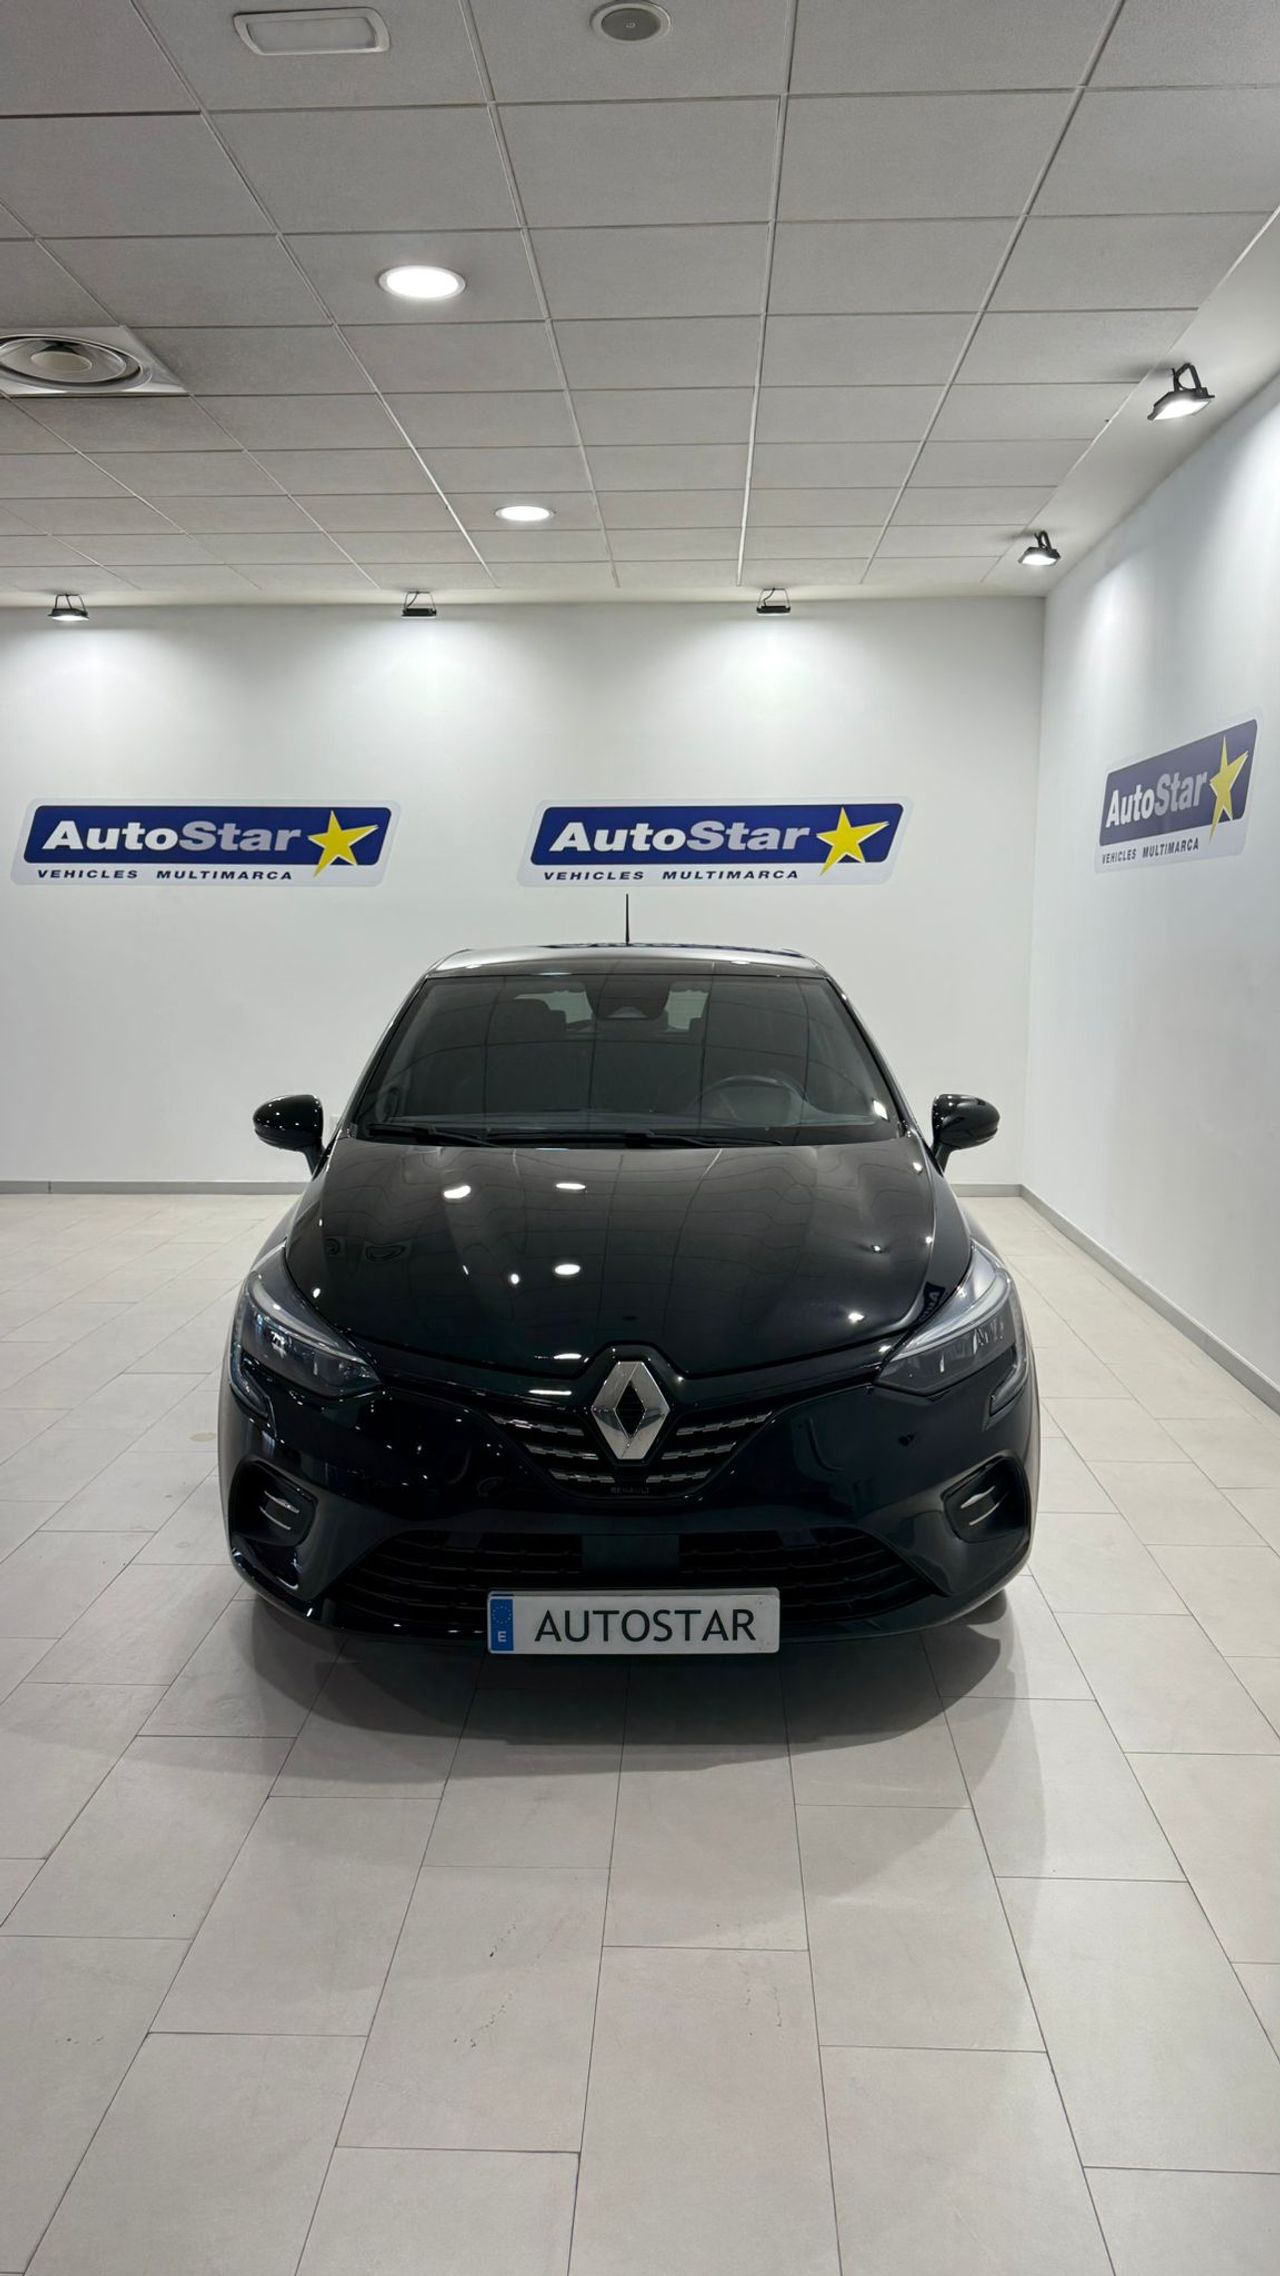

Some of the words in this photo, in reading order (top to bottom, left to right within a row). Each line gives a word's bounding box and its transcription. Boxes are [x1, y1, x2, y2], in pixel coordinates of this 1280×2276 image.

[1105, 771, 1208, 828] AutoStar
[41, 820, 301, 851] AutoStar
[549, 820, 810, 852] AutoStar
[1102, 849, 1137, 864] VEHICLES
[1142, 837, 1199, 858] MULTIMARCA
[37, 869, 138, 879] VEHICLES
[156, 870, 293, 880] MULTIMARCA
[543, 871, 644, 881] VEHICLES
[662, 870, 799, 880] MULTIMARCA
[497, 1631, 507, 1642] E
[534, 1608, 757, 1642] AUTOSTAR
